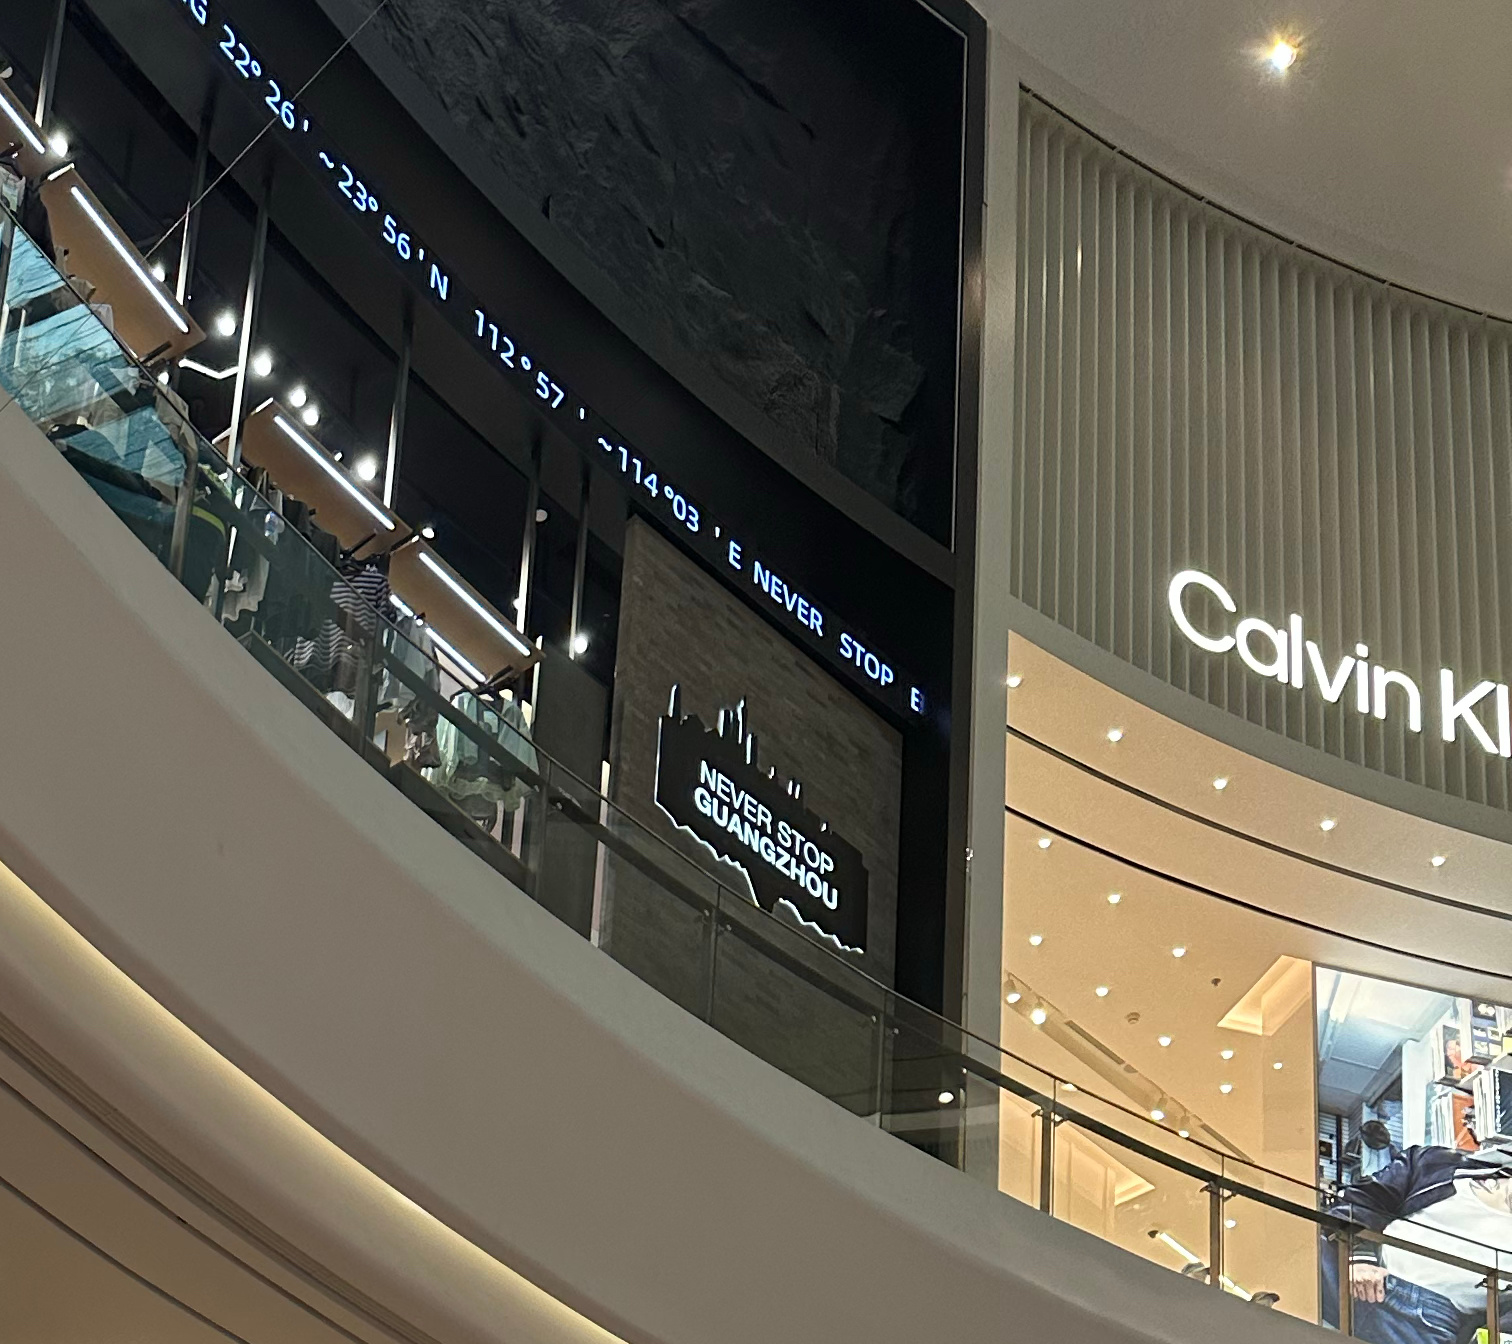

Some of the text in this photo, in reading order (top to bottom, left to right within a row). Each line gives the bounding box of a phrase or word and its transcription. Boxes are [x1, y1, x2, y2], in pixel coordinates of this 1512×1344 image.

[752, 560, 824, 637] NEVER
[838, 632, 895, 687] STOP
[1168, 569, 1422, 733] Calvin
[693, 786, 839, 911] GUANGZHOU
[699, 759, 835, 875] NEVER STOP
